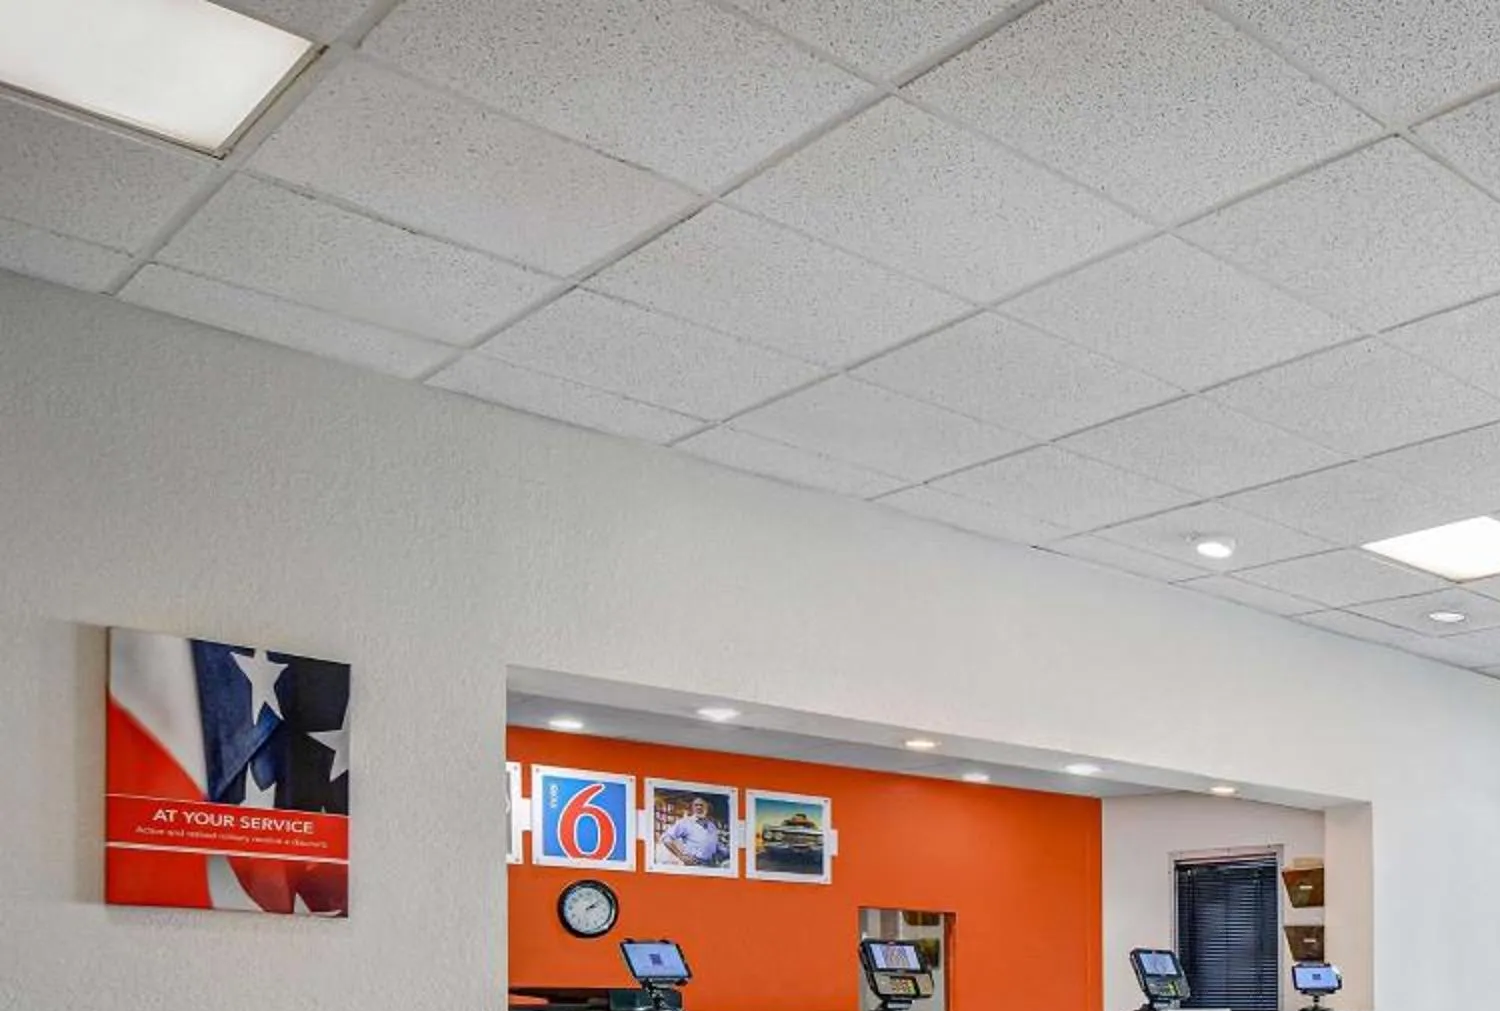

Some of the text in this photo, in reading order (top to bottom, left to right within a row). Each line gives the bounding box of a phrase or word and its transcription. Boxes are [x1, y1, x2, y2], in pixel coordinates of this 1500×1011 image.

[152, 808, 314, 834] AT YOUR SERVICE
[557, 783, 616, 861] 6
